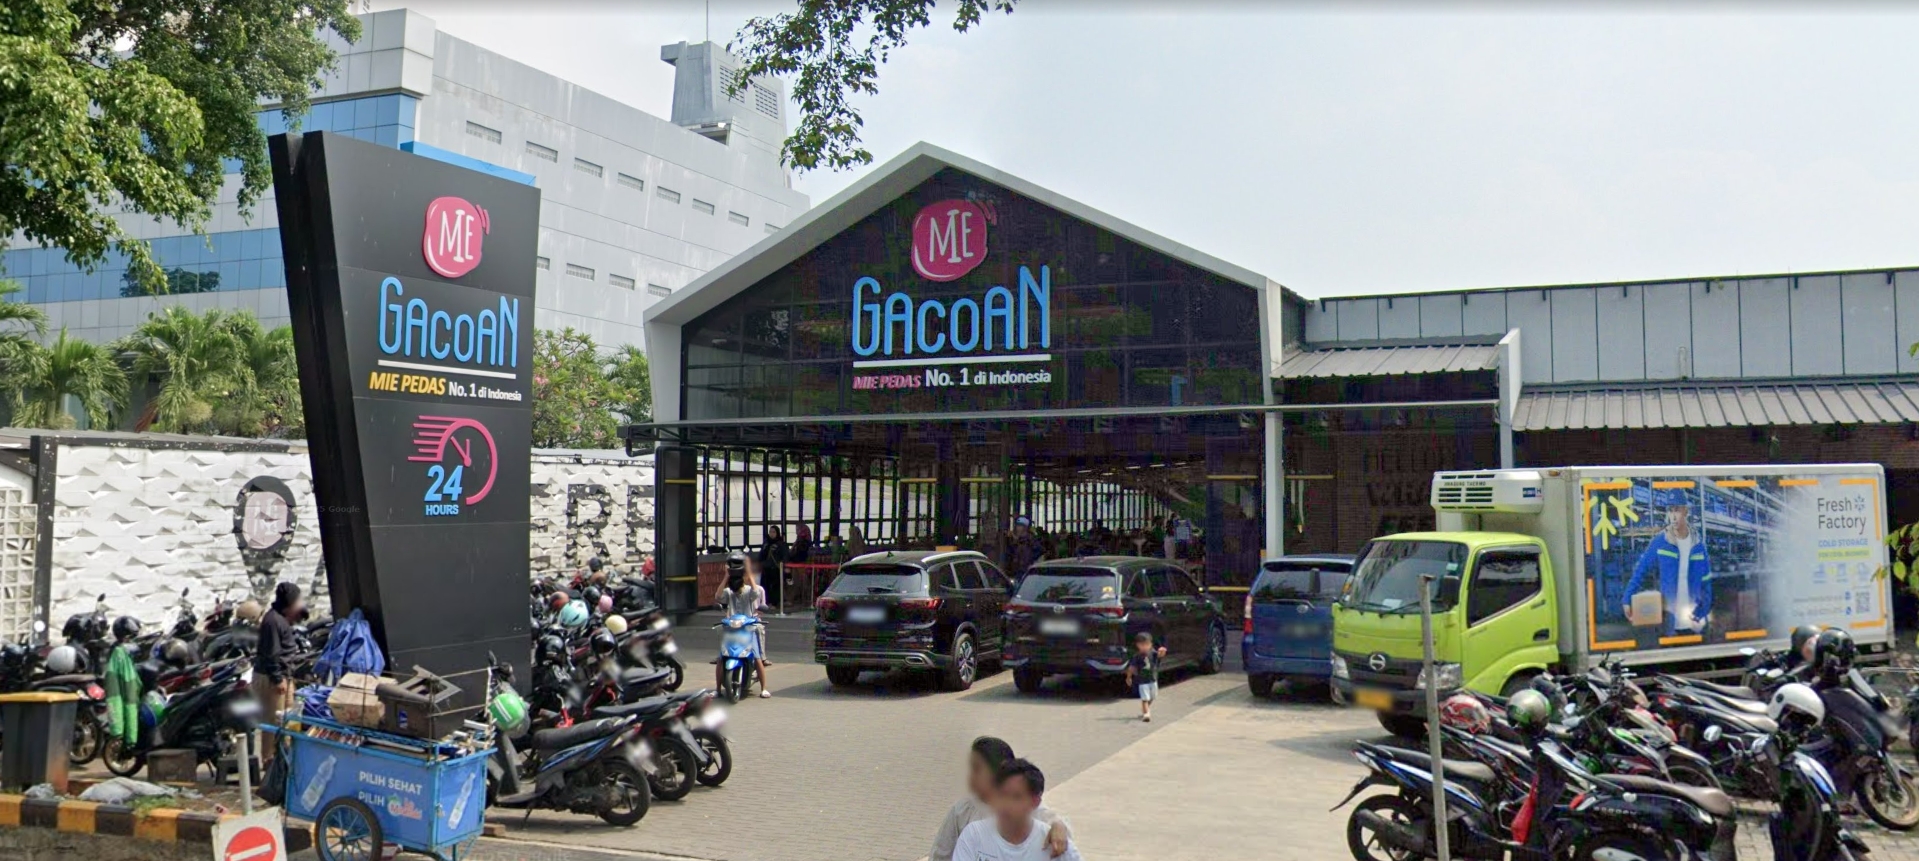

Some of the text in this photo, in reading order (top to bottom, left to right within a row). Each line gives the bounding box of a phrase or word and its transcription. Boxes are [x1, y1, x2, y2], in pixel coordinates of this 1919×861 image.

[369, 371, 522, 401] MIE PEDAS No. 1 di Indonesia
[852, 367, 1051, 390] MIE PEDAS No. 1 di Indonesia
[424, 464, 463, 502] 24
[425, 503, 460, 516] HOURS
[1817, 497, 1852, 512] Fresh
[1818, 514, 1867, 535] Factory
[1838, 538, 1869, 547] STORAGE
[359, 771, 423, 795] PILIH SEHAT
[358, 791, 385, 807] PILIH
